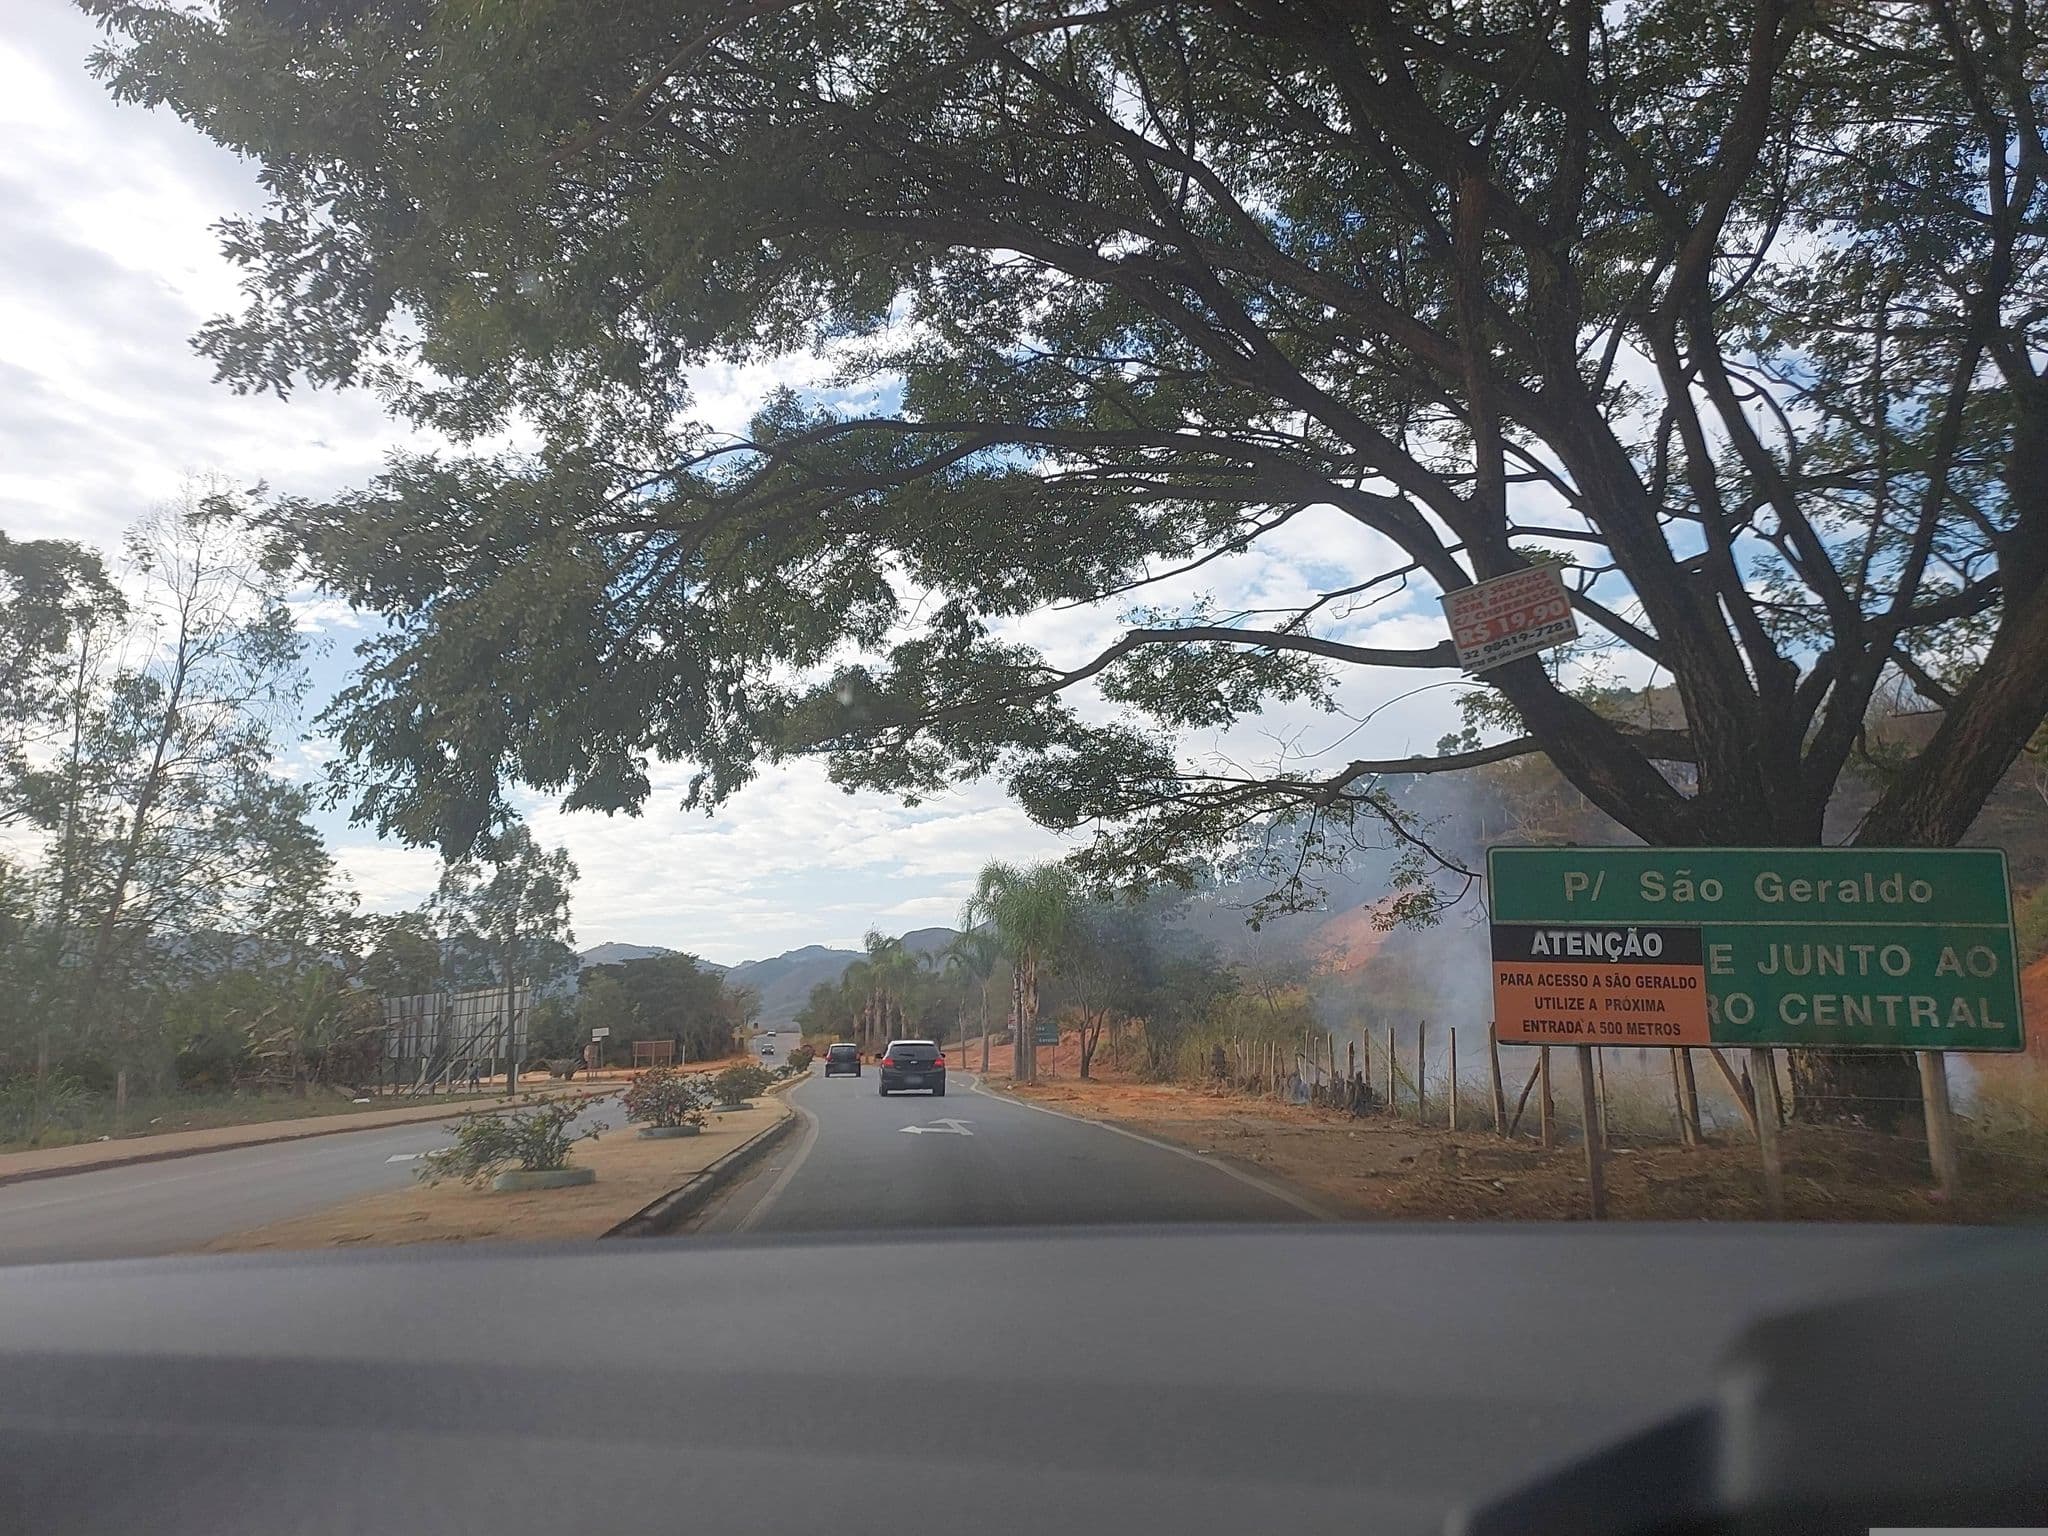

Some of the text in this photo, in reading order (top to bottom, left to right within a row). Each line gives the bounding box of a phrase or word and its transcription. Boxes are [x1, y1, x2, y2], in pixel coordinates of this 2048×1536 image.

[1564, 869, 1933, 903] P/ São Geraldo
[1531, 927, 1663, 963] ATENÇÃO
[1709, 944, 1998, 978] E JUNTO AO
[1500, 973, 1697, 989] PARA ACESSO A SÃO GERALDO
[1534, 996, 1665, 1012] UTILIZE A PRÓXIMA
[1778, 993, 2006, 1029] CENTRAL
[1523, 1019, 1583, 1034] ENTRADA
[1600, 1021, 1623, 1034] 500
[1627, 1022, 1681, 1036] METROS
